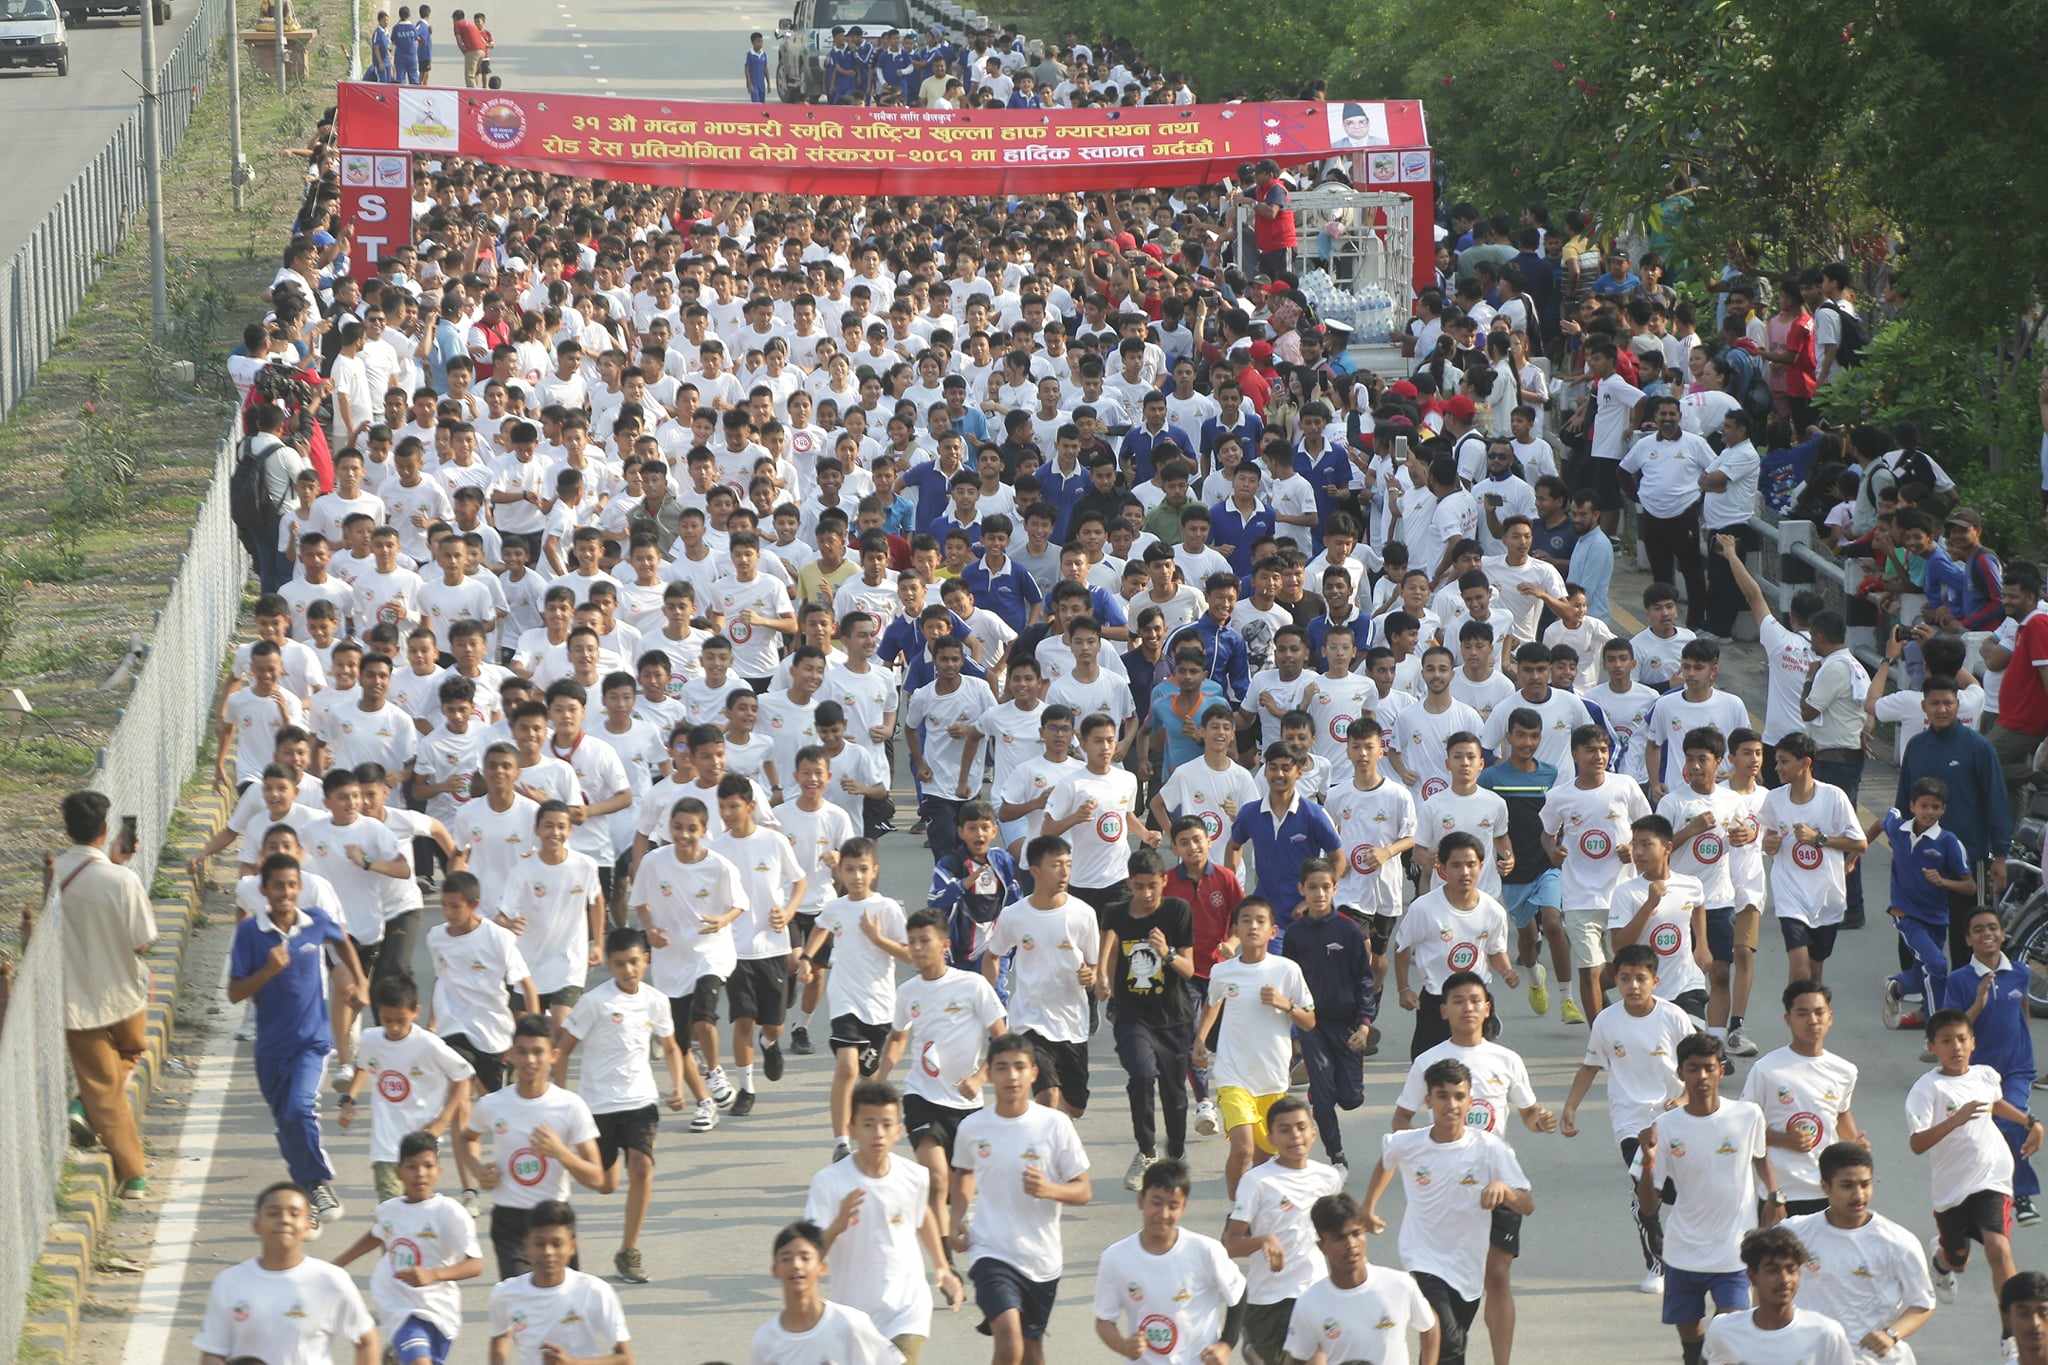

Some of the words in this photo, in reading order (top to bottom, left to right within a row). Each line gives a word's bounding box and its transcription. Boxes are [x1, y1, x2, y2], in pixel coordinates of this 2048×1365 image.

[571, 115, 600, 131] ३१
[643, 118, 698, 135] मदन
[703, 119, 784, 137] भण्डारी
[928, 125, 994, 143] खुल्ला
[999, 125, 1049, 140] हाफ
[1055, 123, 1152, 139] म्याराथन
[1157, 121, 1201, 135] तथा
[541, 135, 582, 154] रोड
[588, 136, 625, 157] रेस
[630, 139, 742, 160] प्रतियोगिता
[970, 147, 997, 162] मा
[1002, 143, 1071, 163] हार्दिक
[1077, 143, 1146, 161] स्वागत
[1467, 1112, 1488, 1125] 607
